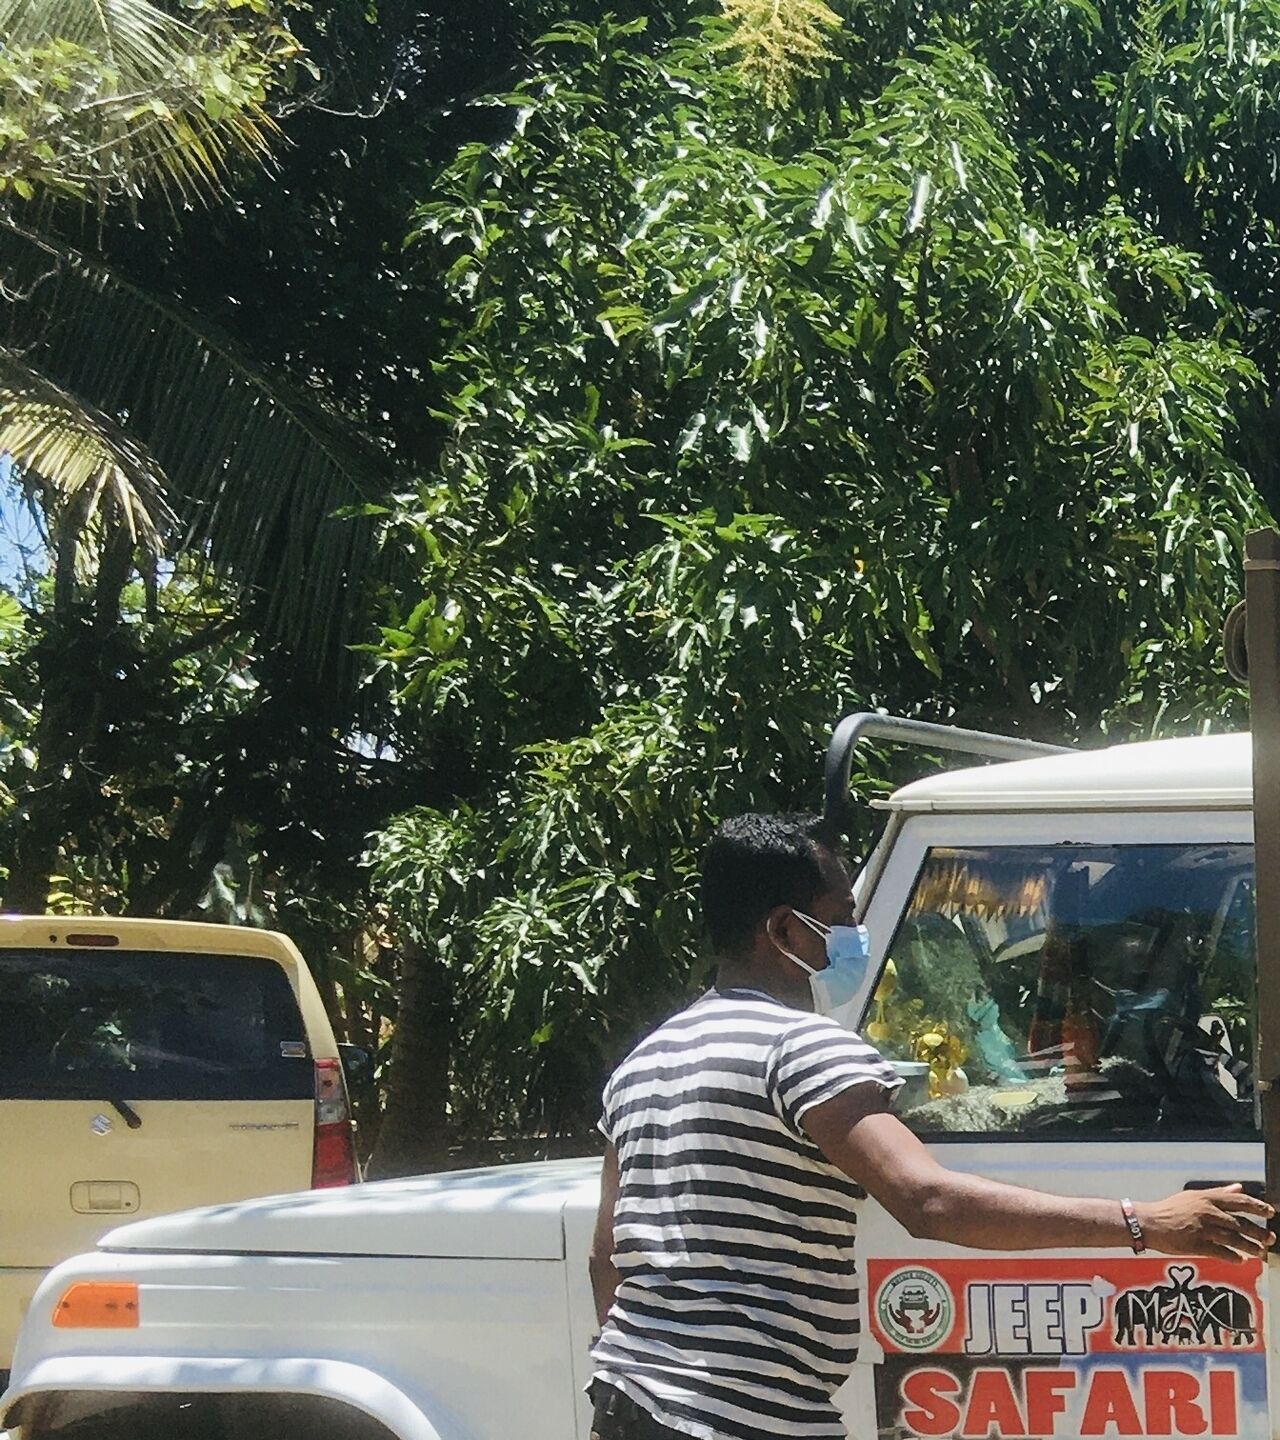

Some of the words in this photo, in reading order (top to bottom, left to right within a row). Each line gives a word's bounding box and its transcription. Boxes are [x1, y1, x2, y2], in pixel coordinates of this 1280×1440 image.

[965, 1283, 1103, 1355] JEEP
[1127, 1291, 1242, 1334] MAXI
[903, 1370, 1238, 1436] SAFARI
